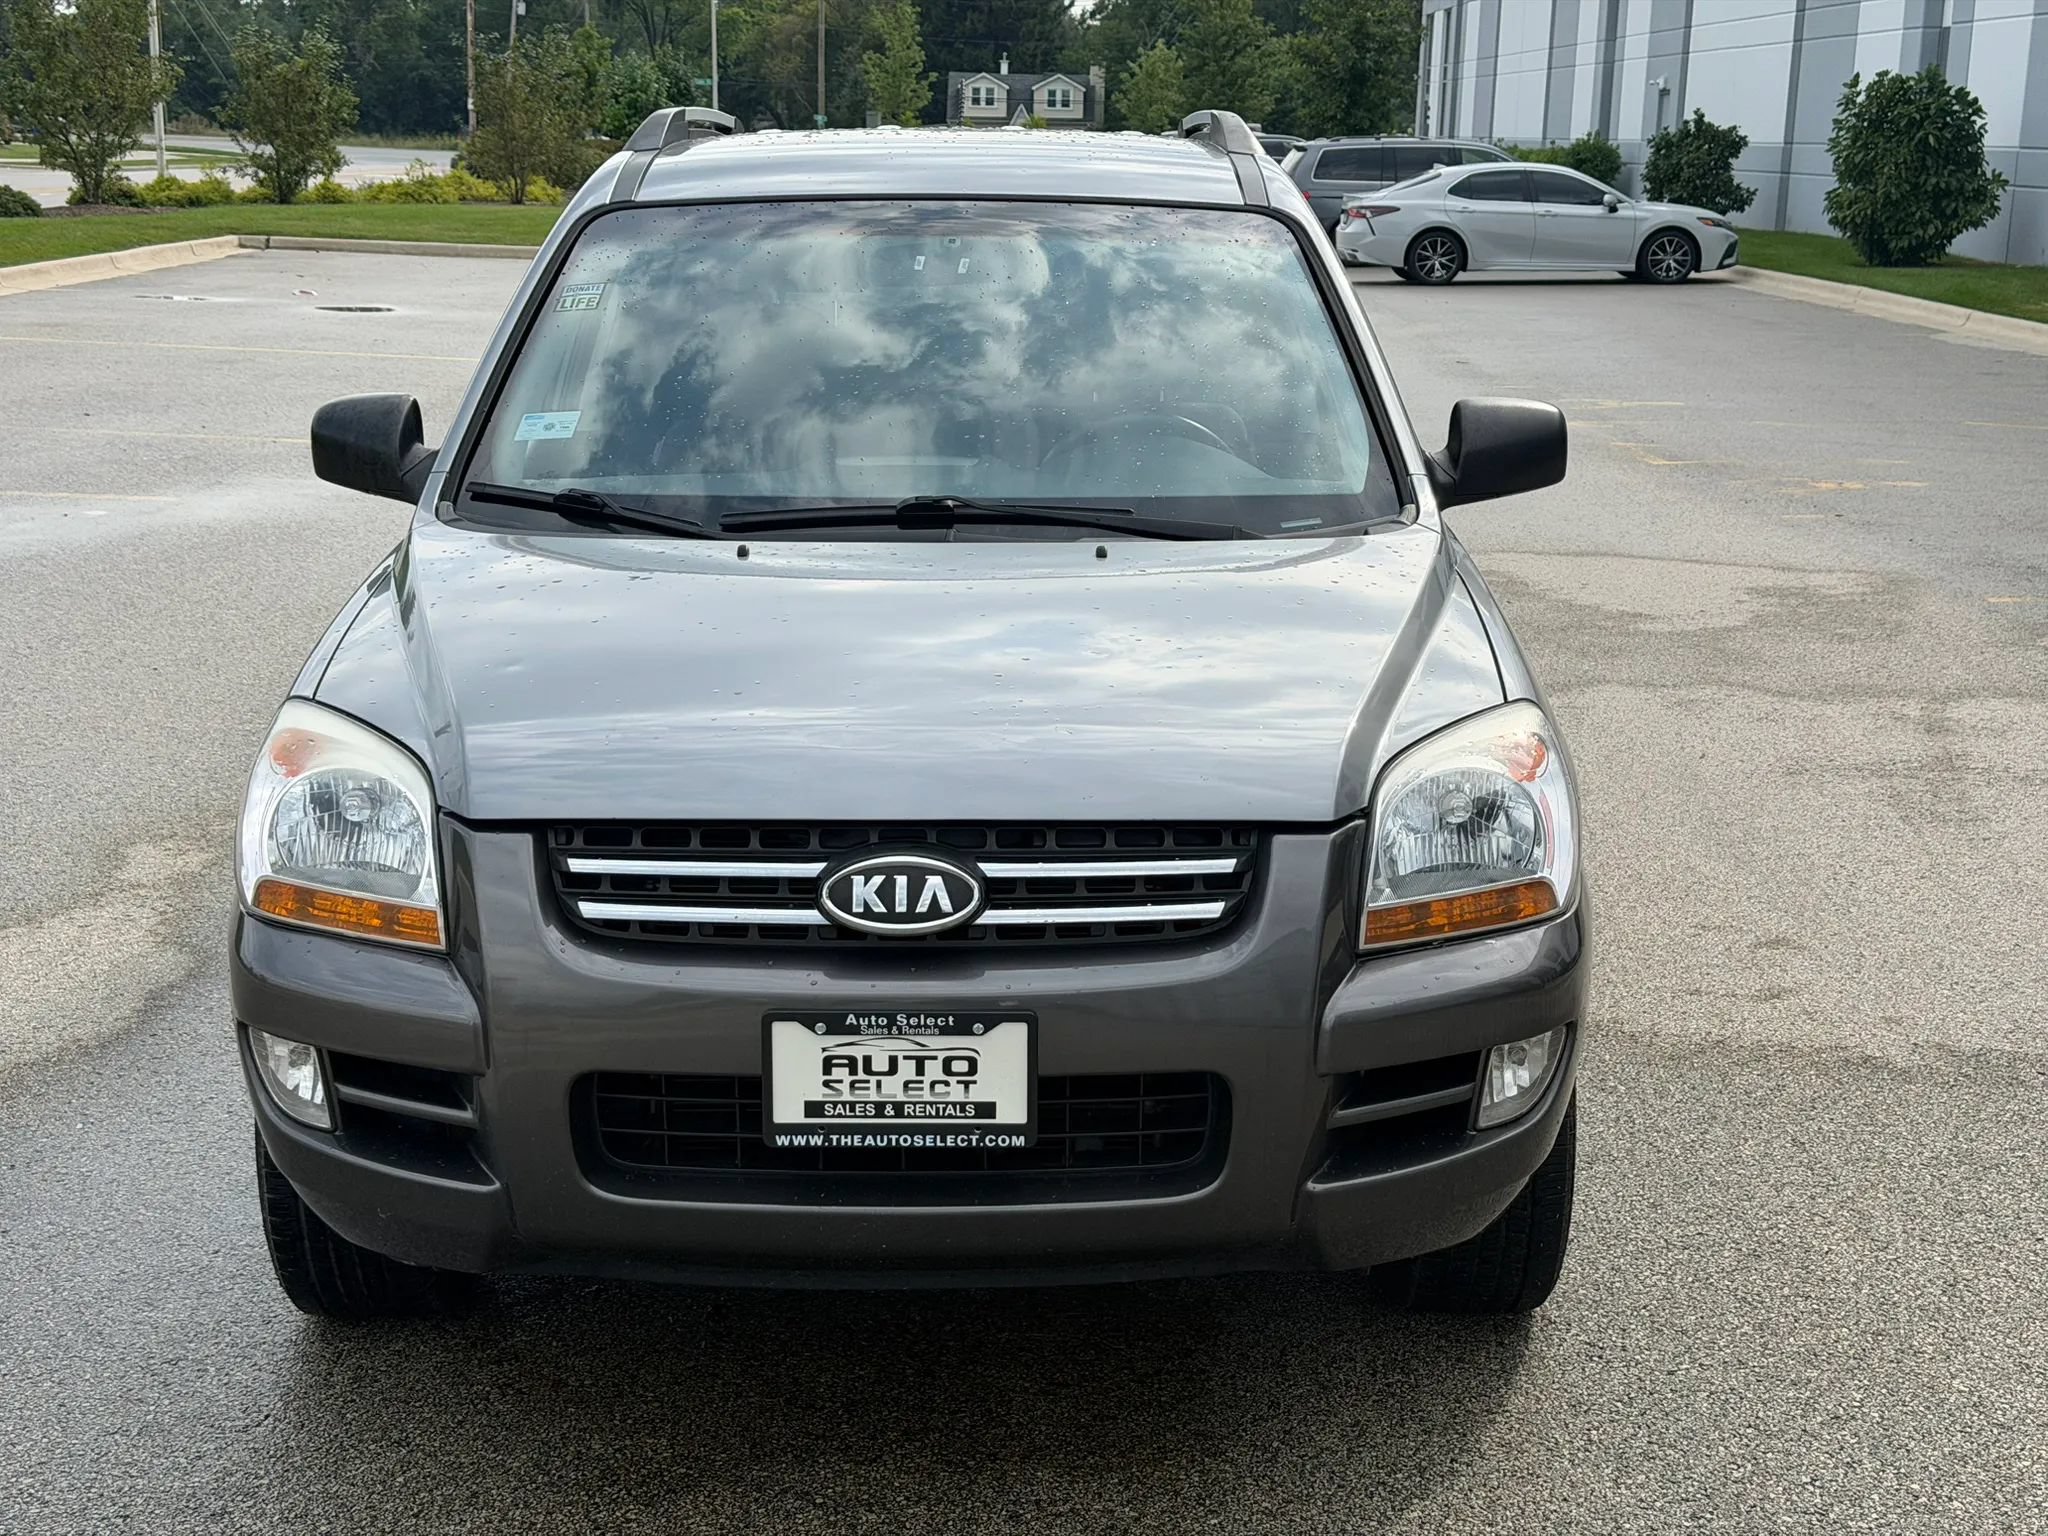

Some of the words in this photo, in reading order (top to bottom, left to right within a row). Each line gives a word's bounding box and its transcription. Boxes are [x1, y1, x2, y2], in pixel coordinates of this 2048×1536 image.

[560, 297, 598, 309] LIFE
[851, 875, 953, 913] KIA
[845, 1014, 888, 1026] Auto
[896, 1014, 955, 1026] Select
[860, 1026, 887, 1035] Sales
[891, 1026, 899, 1035] &
[902, 1026, 940, 1035] Rentals
[822, 1055, 978, 1077] AUTO
[821, 1079, 978, 1099] SELECT
[824, 1103, 876, 1116] SALES
[884, 1104, 895, 1116] &
[904, 1104, 975, 1116] RENTALS
[775, 1134, 1026, 1147] WWW.THEAUTOSELECT.COM
